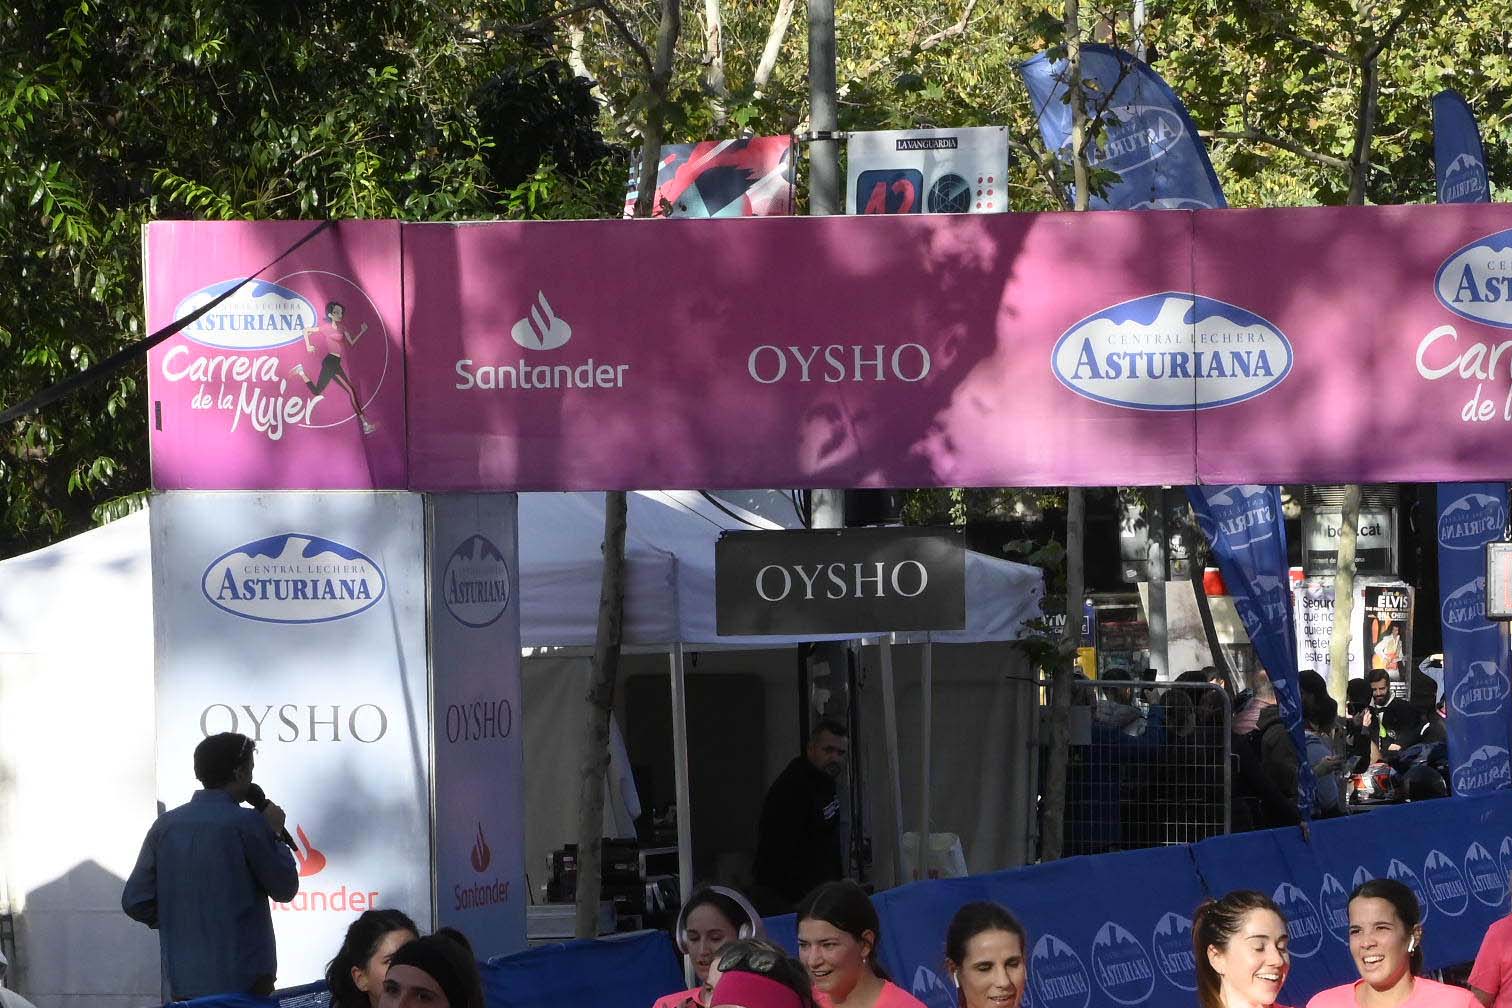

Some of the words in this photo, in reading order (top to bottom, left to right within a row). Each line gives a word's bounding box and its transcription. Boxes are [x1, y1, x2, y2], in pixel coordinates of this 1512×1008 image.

[1107, 333, 1182, 345] CENTRAL
[1190, 332, 1266, 344] LECHERA
[162, 345, 279, 382] Carrera
[455, 358, 629, 390] Santander
[748, 344, 931, 385] OYSHO
[1070, 337, 1275, 380] ASTURIANA
[191, 384, 213, 410] de
[217, 384, 234, 410] la
[230, 379, 325, 441] Mujer
[1461, 384, 1495, 422] de
[217, 567, 373, 601] ASTURIANA
[244, 564, 303, 574] CENTRAL
[307, 564, 366, 574] LECHERA
[755, 560, 928, 603] OYSHO
[449, 570, 508, 606] ASTURIANA
[1377, 595, 1408, 608] ELVIS
[200, 703, 388, 744] OYSHO
[446, 699, 512, 744] OYSHO
[454, 878, 510, 911] Santander
